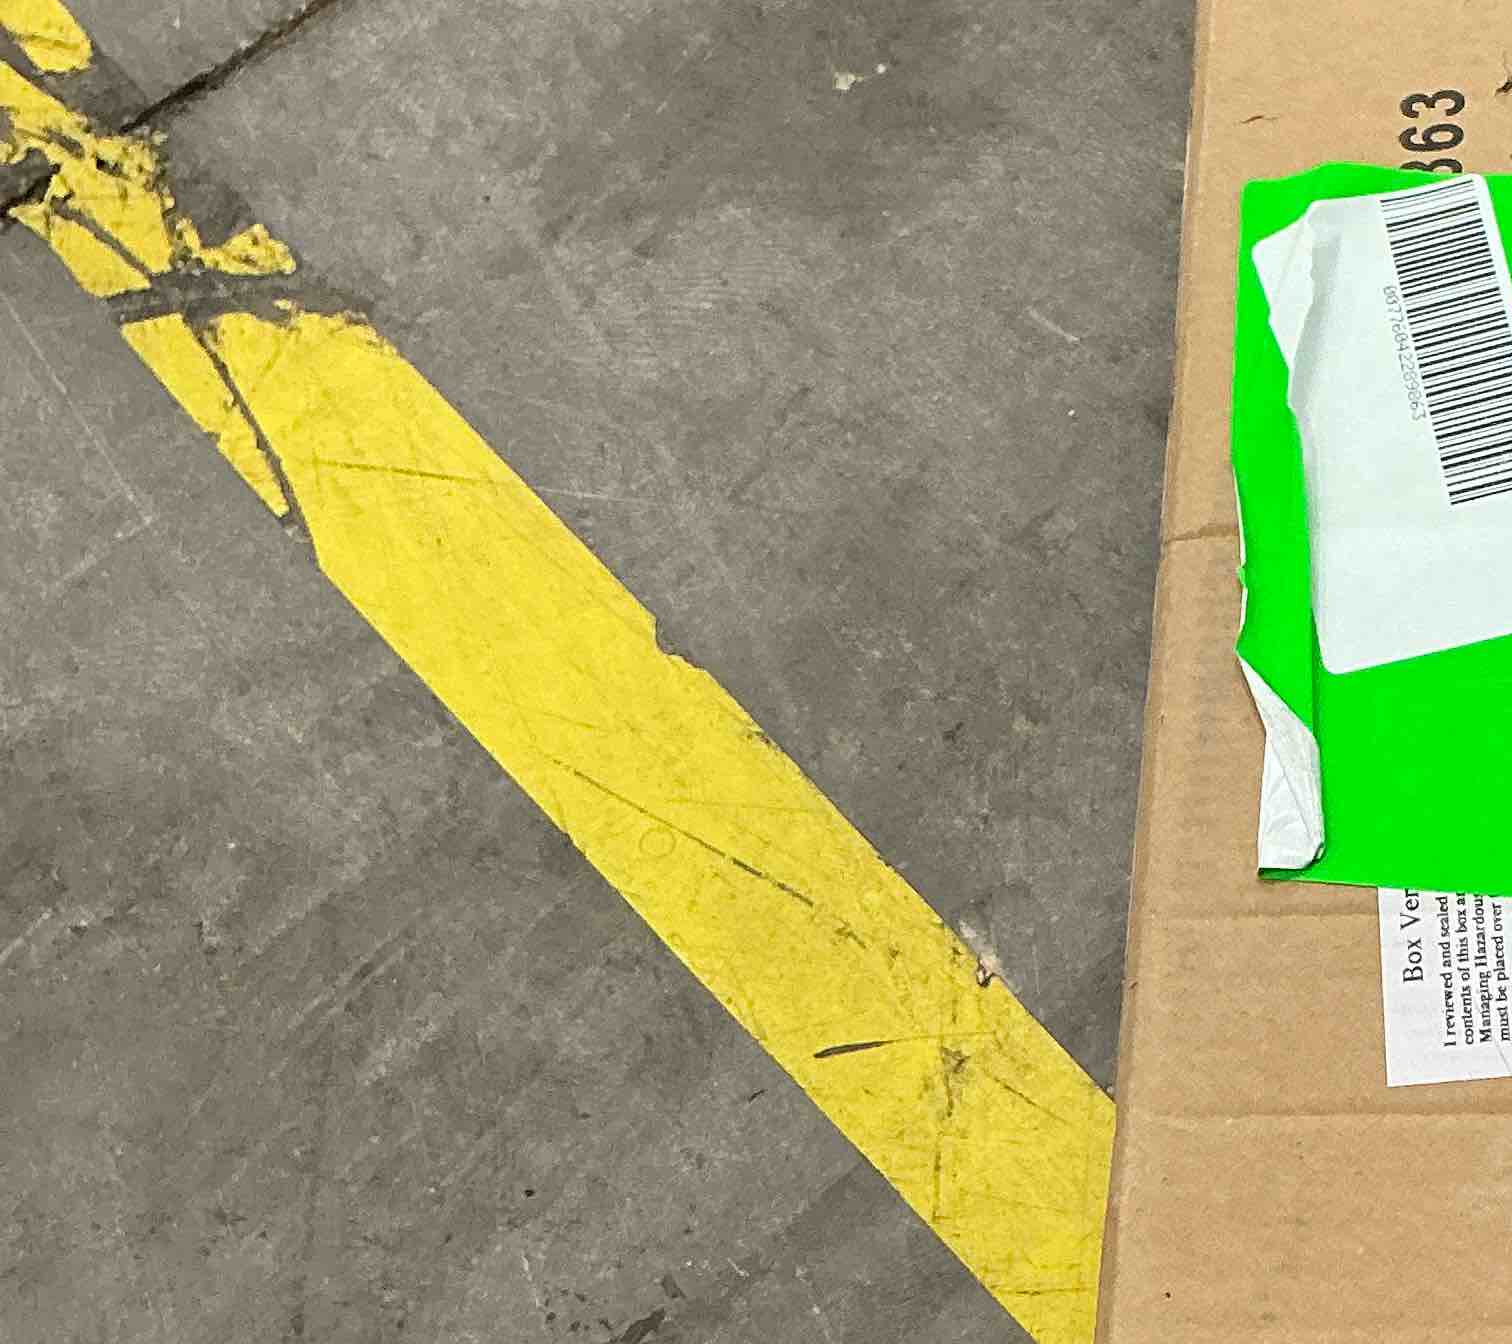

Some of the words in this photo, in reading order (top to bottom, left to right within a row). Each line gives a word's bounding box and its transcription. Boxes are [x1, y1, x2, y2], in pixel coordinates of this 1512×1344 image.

[1435, 896, 1449, 937] sealed
[1455, 909, 1467, 932] box
[1492, 903, 1503, 931] over
[1402, 937, 1423, 984] Box
[1438, 941, 1451, 967] and
[1456, 937, 1469, 962] this
[1491, 936, 1509, 981] placed
[1457, 967, 1470, 981] of
[1440, 973, 1456, 1036] reviewed
[1479, 971, 1492, 1042] Managing
[1495, 986, 1507, 1001] be
[1460, 986, 1474, 1044] contents
[1496, 1006, 1510, 1041] must
